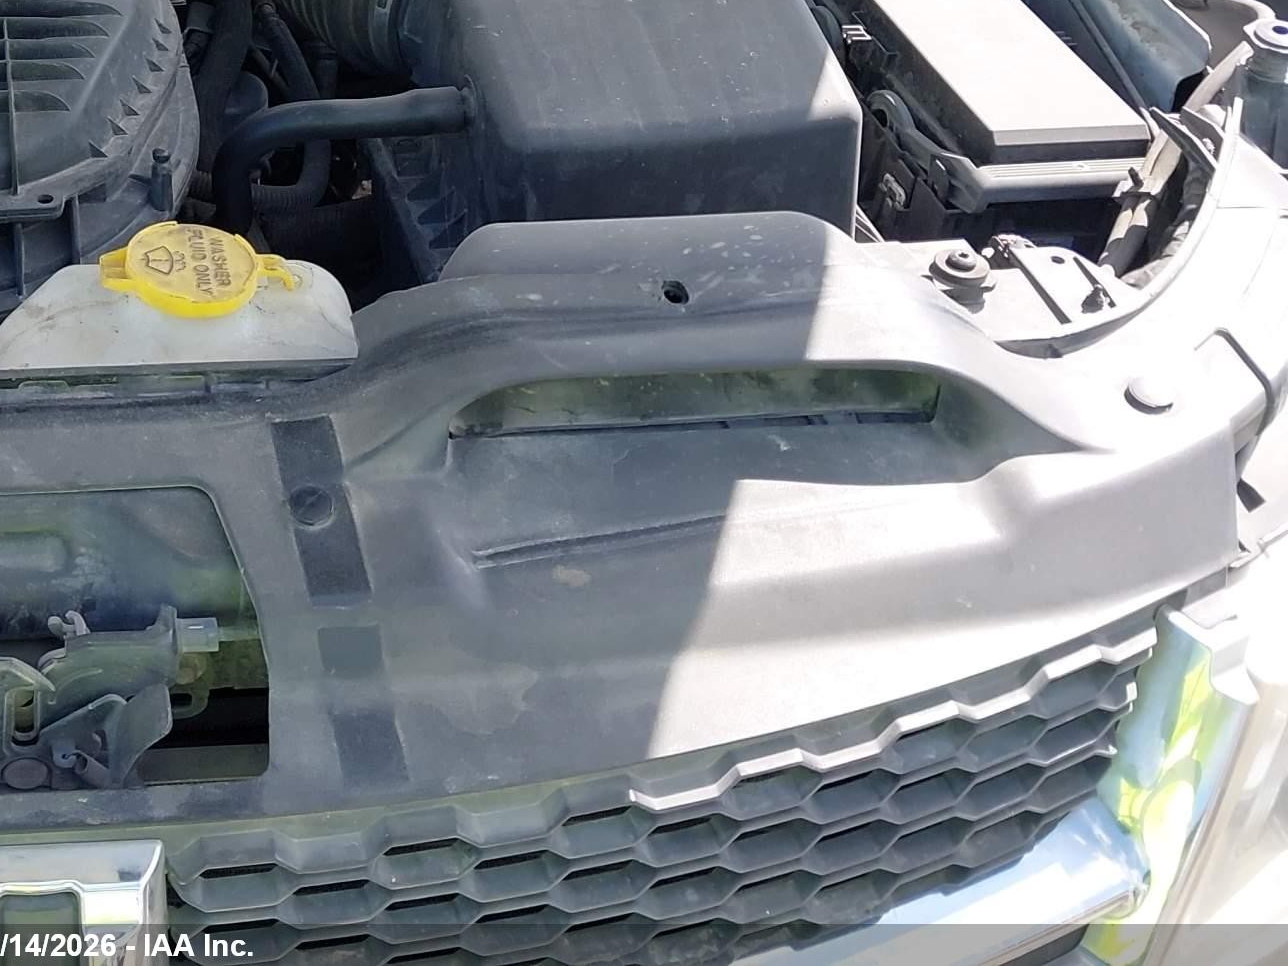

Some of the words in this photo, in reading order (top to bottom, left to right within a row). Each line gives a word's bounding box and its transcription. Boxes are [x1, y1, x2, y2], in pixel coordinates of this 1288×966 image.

[185, 228, 207, 262] FLUID
[208, 235, 232, 288] WASHER
[192, 264, 215, 296] ONLY
